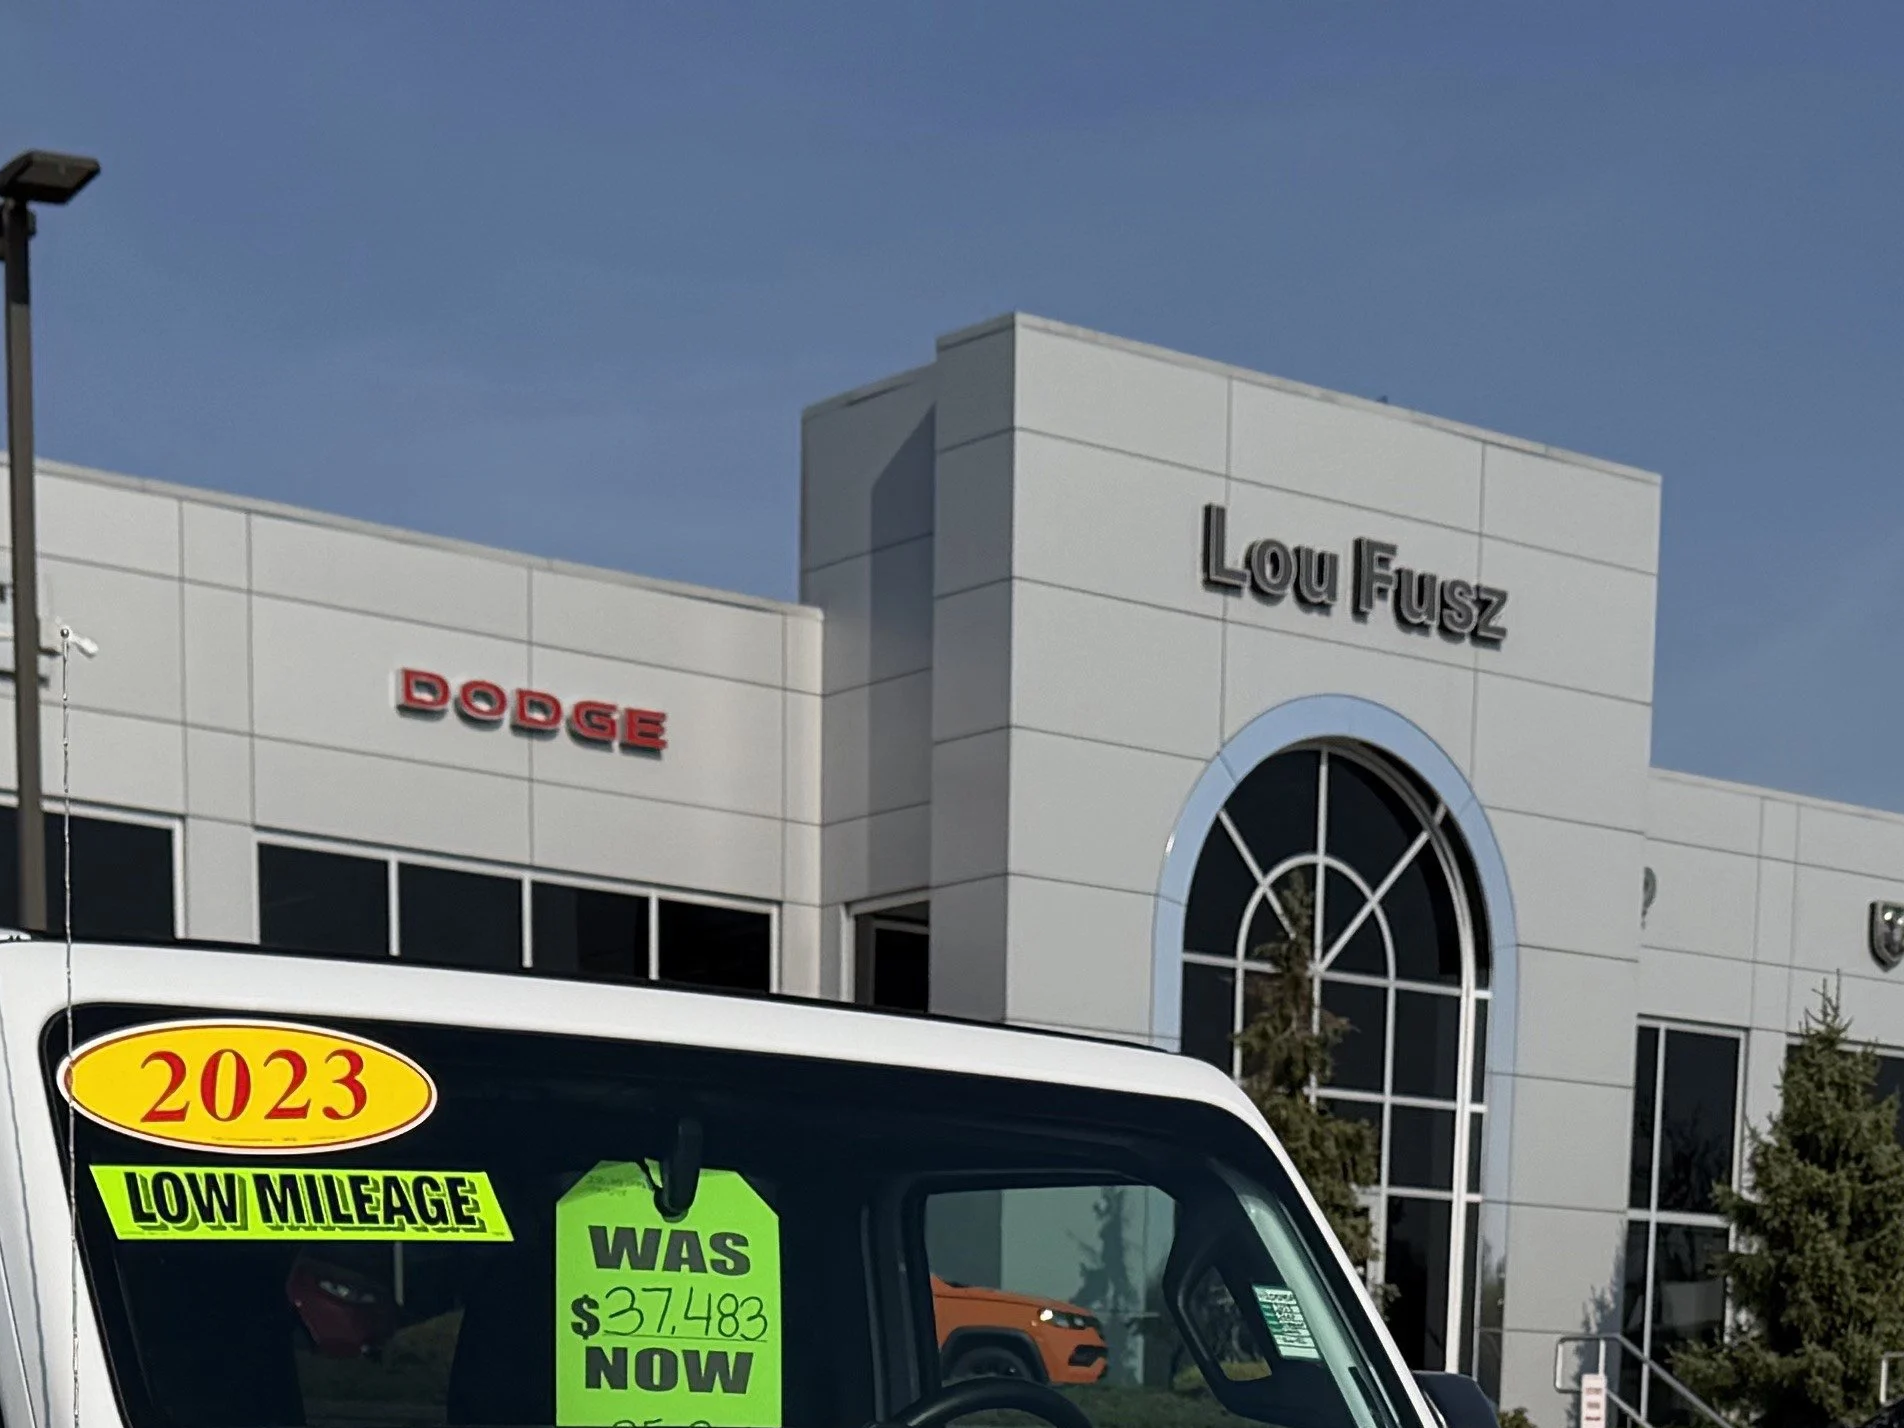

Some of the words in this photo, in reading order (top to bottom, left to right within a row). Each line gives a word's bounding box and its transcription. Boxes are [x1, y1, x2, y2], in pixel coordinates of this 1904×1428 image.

[1202, 502, 1339, 606] Lou
[1353, 535, 1509, 642] Fusz
[397, 666, 669, 752] DODGE
[140, 1048, 368, 1123] 2023
[123, 1170, 249, 1232] LOW
[251, 1172, 488, 1234] MILEAGE
[587, 1225, 751, 1276] WAS
[585, 1345, 754, 1395] NOW
